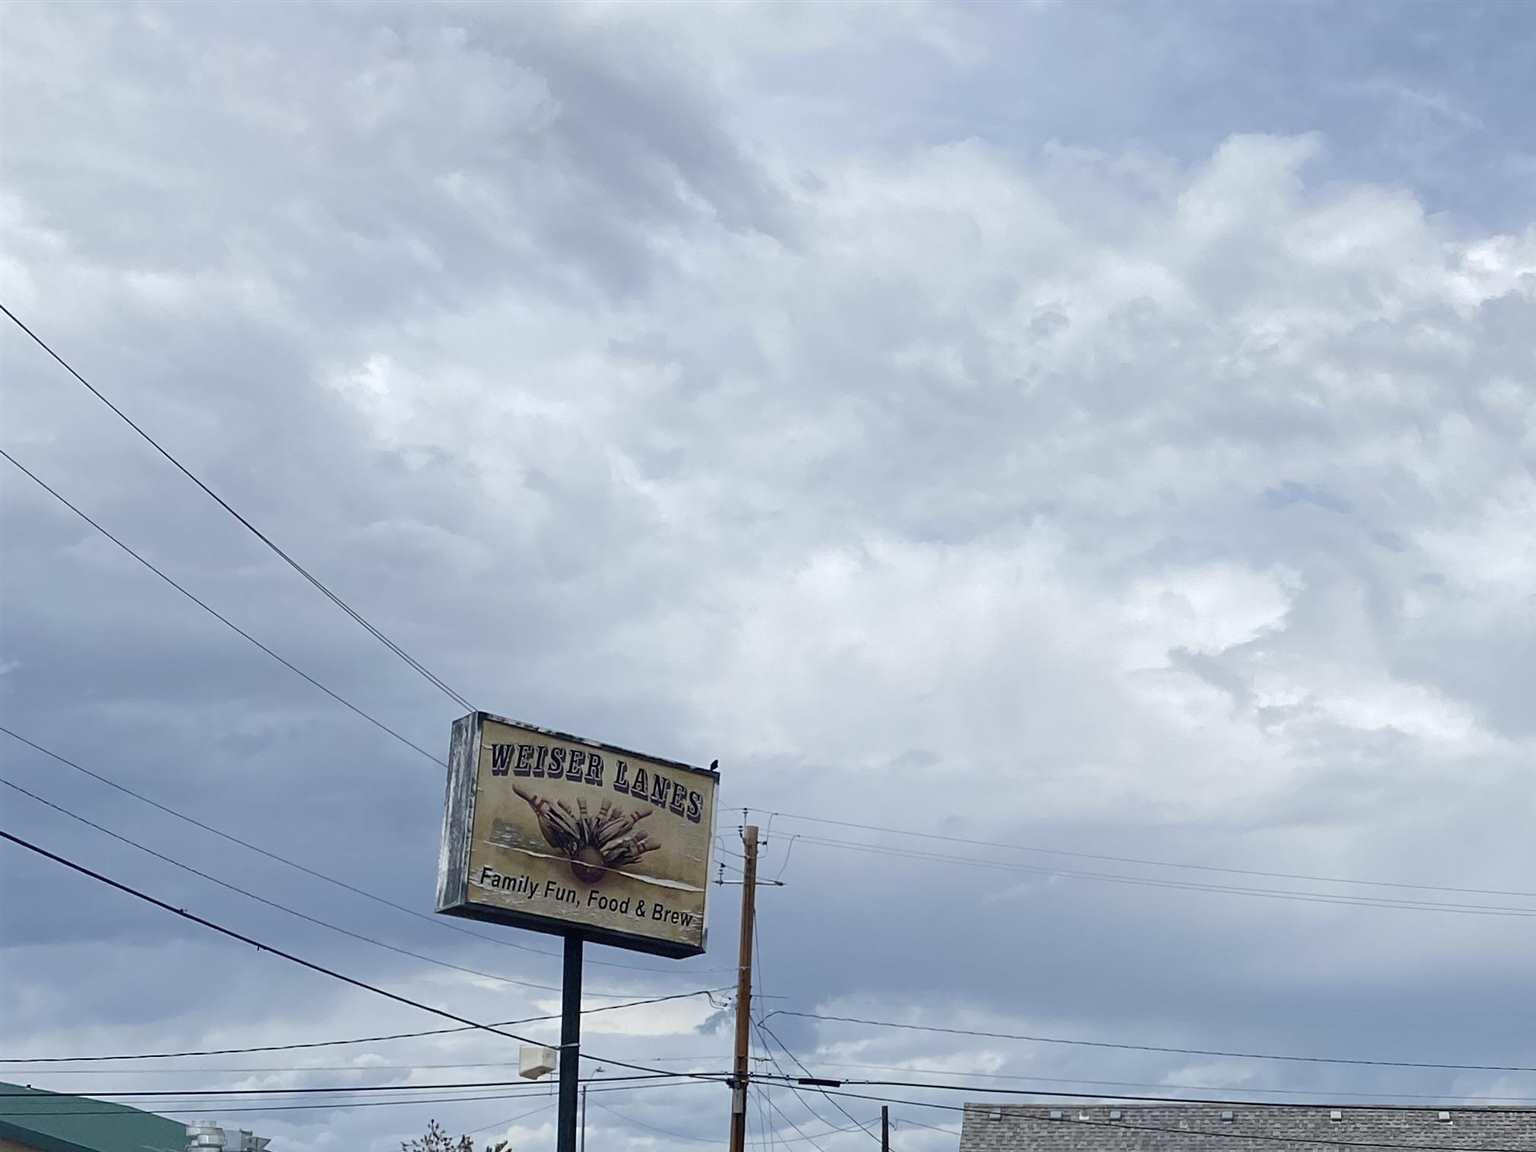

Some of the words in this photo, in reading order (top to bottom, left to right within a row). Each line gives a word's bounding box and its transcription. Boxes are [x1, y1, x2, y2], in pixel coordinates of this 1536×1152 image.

[491, 743, 604, 786] WEISER
[613, 760, 704, 824] LANES
[479, 866, 539, 900] Family
[543, 880, 581, 907] Fun,
[587, 890, 629, 915] Food
[634, 900, 647, 918] &
[651, 905, 693, 928] Brew
